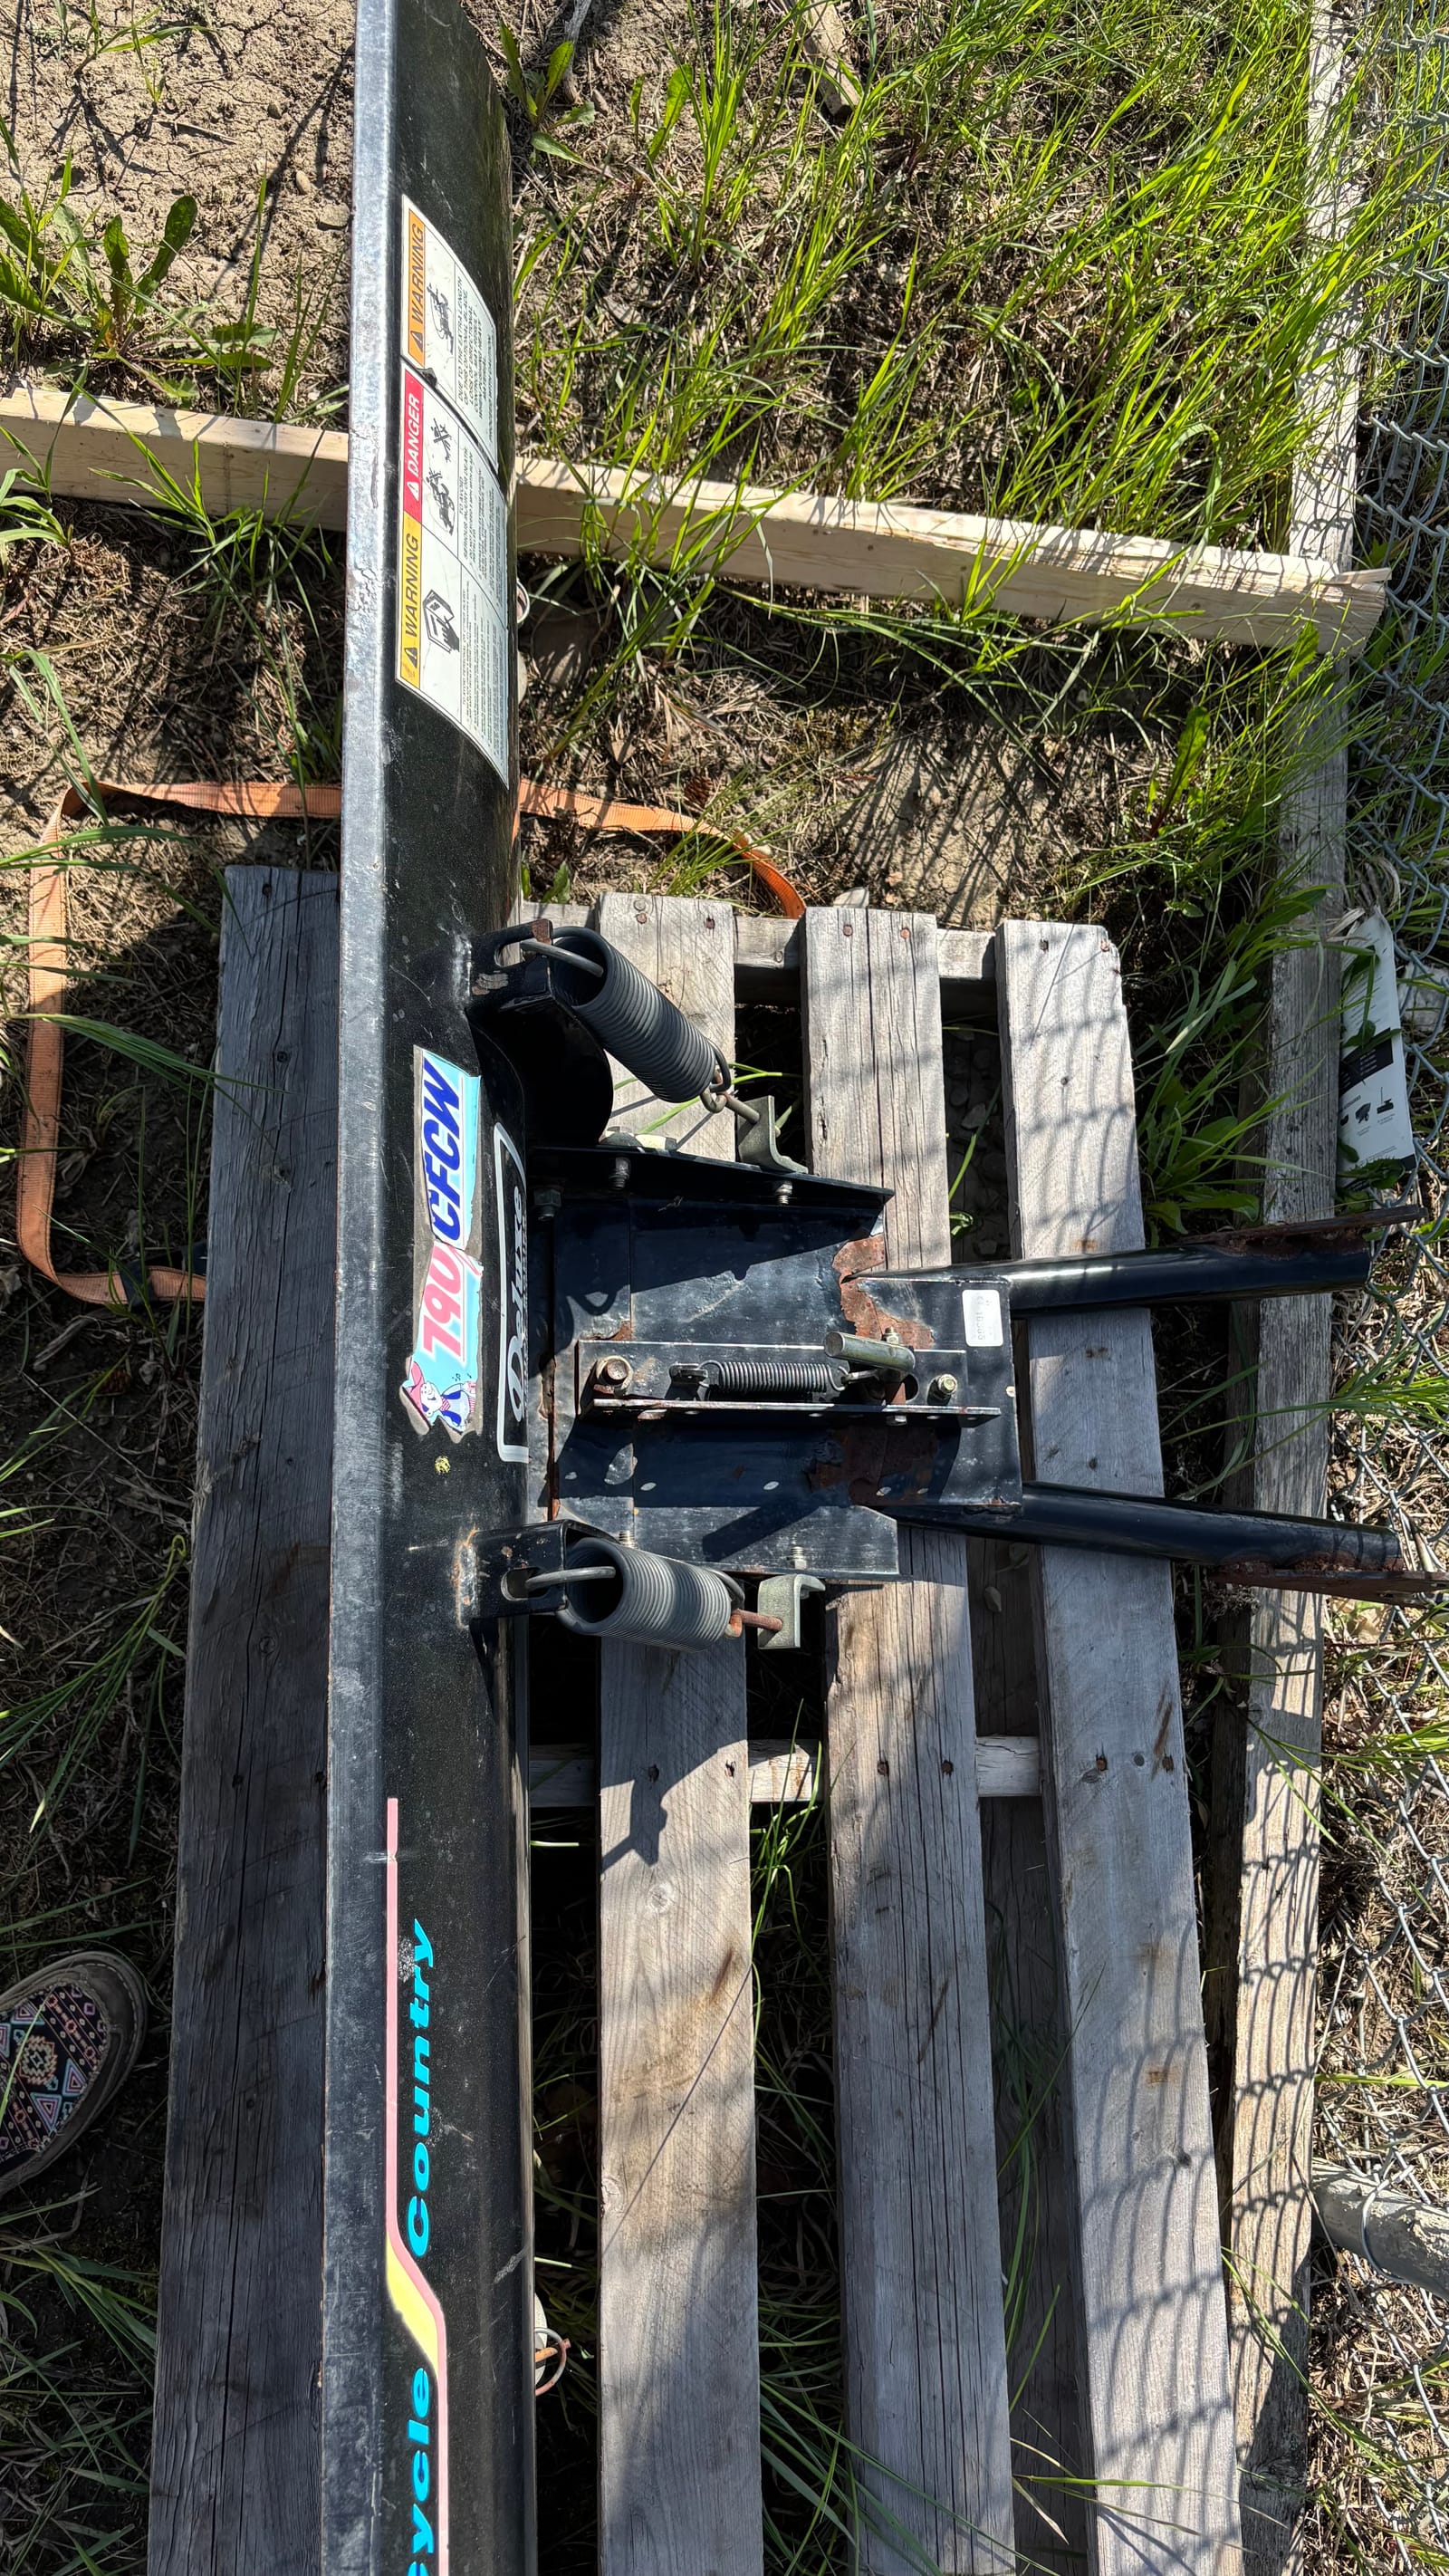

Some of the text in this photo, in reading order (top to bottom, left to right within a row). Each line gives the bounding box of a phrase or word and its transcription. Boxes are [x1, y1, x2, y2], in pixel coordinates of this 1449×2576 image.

[411, 223, 424, 324] WARNING
[458, 366, 463, 379] TO
[464, 391, 468, 406] OF
[408, 393, 419, 477] DANGER
[405, 533, 418, 638] WARNING
[423, 1058, 461, 1358] 790 CFCW
[507, 1187, 523, 1423] Deluxe
[407, 1918, 434, 2258] Country
